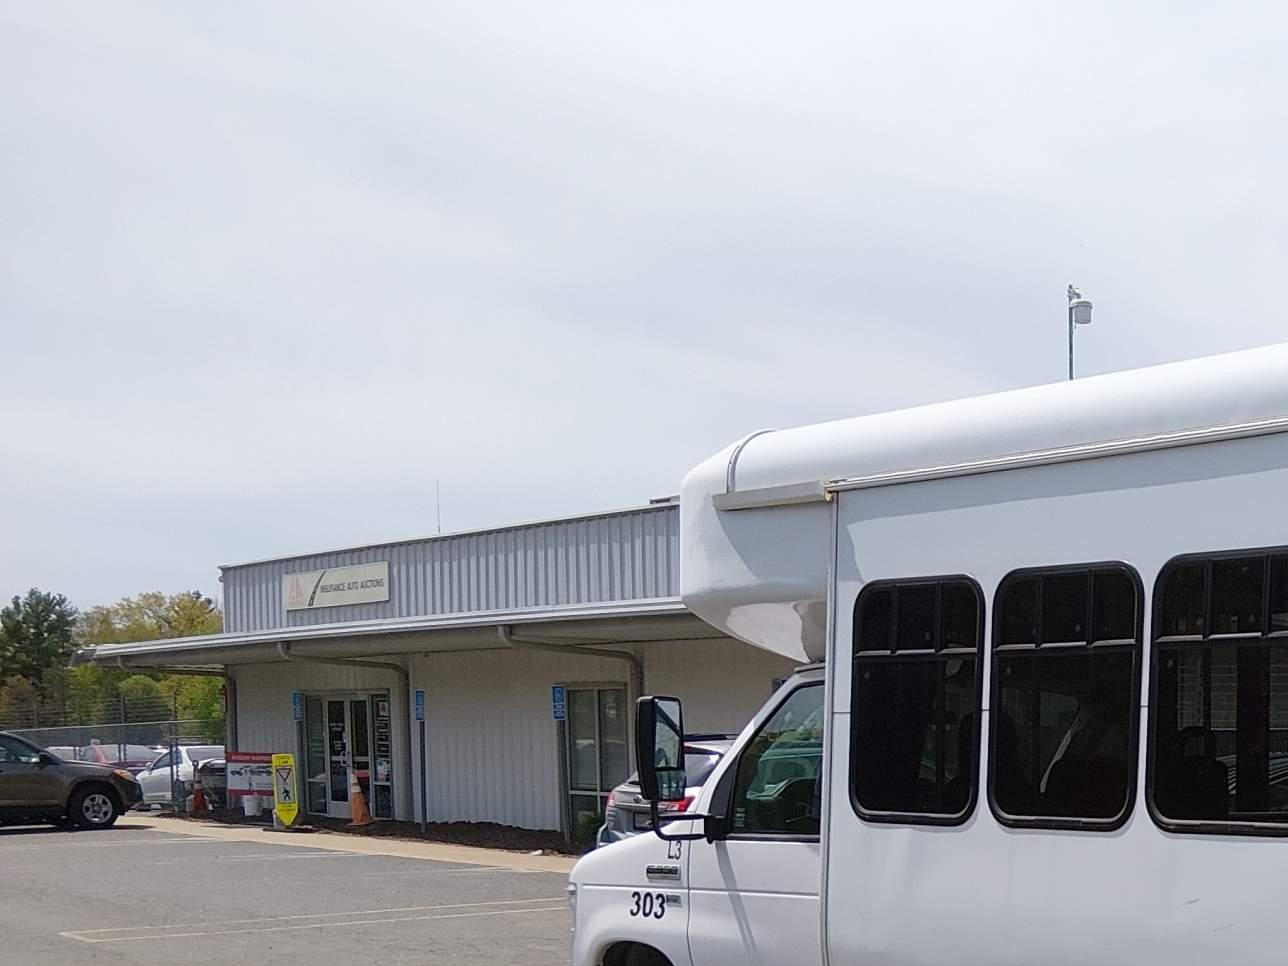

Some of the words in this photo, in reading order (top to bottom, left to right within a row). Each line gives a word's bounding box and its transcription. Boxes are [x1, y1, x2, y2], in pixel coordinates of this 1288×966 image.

[347, 581, 359, 591] AUTO
[360, 578, 384, 589] AUCTIONS
[667, 840, 682, 859] L3
[629, 891, 666, 919] 303
